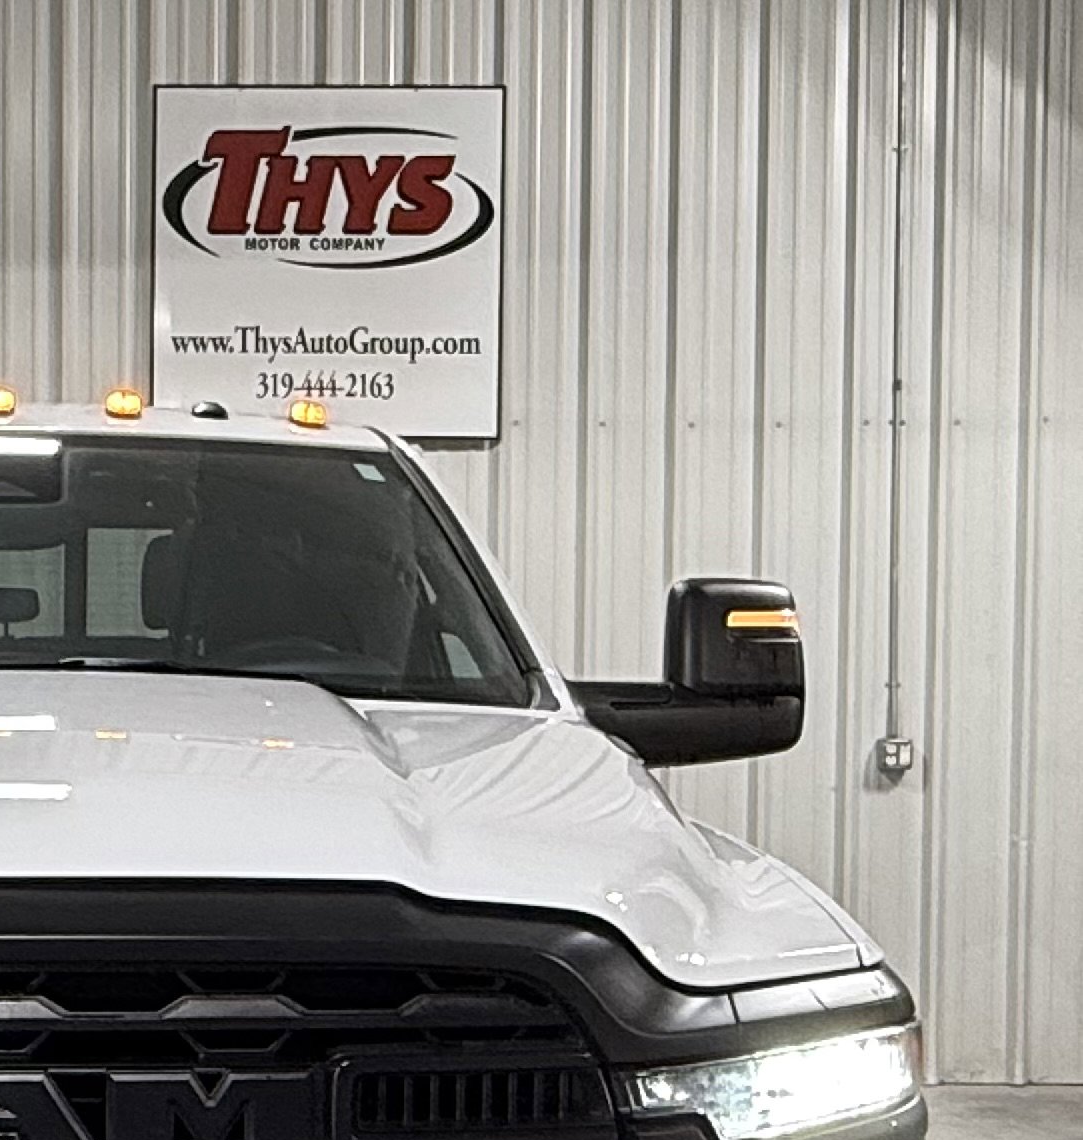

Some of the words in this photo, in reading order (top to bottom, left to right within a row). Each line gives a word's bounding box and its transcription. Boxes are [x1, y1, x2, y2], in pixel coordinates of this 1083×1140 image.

[203, 126, 456, 235] THYS
[244, 238, 300, 250] MOTOR
[309, 238, 385, 251] COMPANY
[171, 326, 481, 364] www.ThysAutoGroup.com
[255, 371, 395, 399] 319-444-2163
